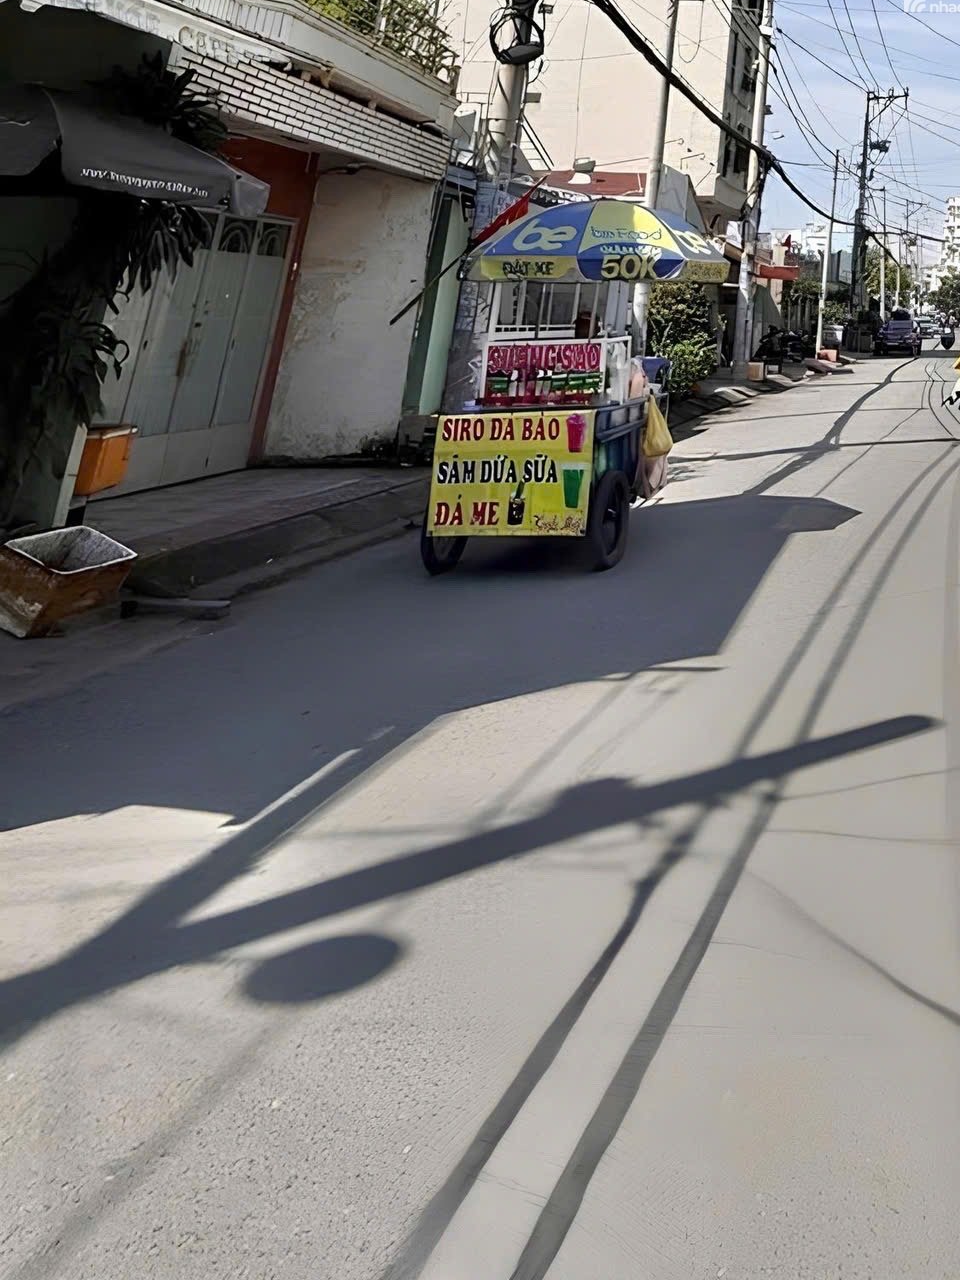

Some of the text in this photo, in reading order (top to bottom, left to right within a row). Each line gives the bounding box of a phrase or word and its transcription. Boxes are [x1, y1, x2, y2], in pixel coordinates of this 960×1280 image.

[513, 219, 577, 251] be
[601, 254, 657, 279] 50K
[442, 418, 485, 441] SIRO
[469, 501, 500, 526] ME
